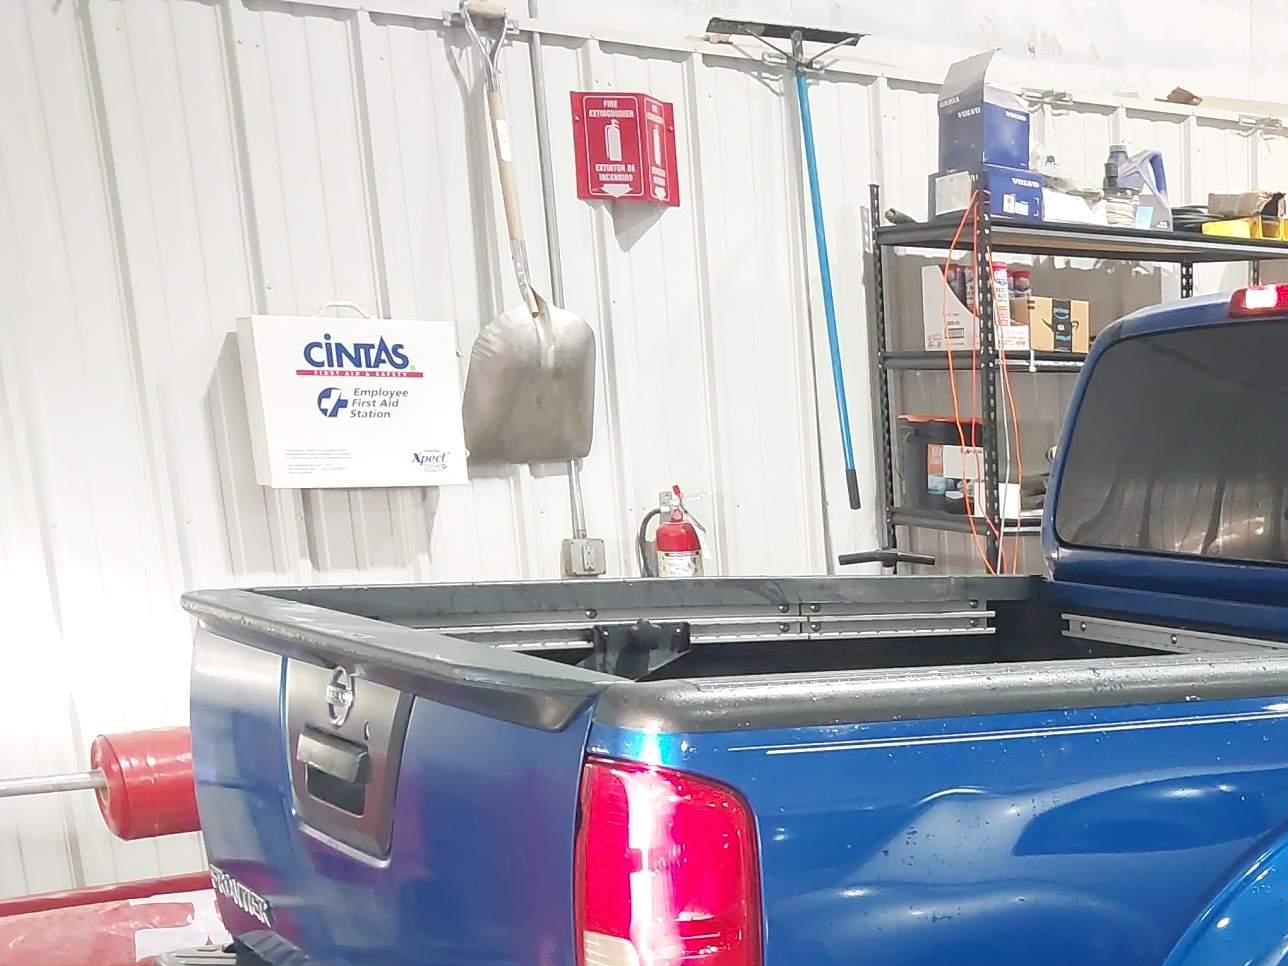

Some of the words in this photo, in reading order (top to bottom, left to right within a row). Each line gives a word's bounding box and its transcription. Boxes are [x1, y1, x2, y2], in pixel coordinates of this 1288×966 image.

[603, 100, 618, 108] FIRE
[588, 109, 635, 117] EXTINGUISHER
[957, 107, 981, 118] VOLVO
[1005, 111, 1027, 121] VOLVO
[1011, 178, 1040, 188] VOLVO
[303, 333, 409, 370] CINTAS
[353, 387, 409, 398] Employee
[351, 398, 376, 408] First
[379, 397, 399, 408] Aid
[349, 409, 391, 418] Station
[411, 452, 446, 466] Xpect
[209, 864, 271, 928] FRONTIER
